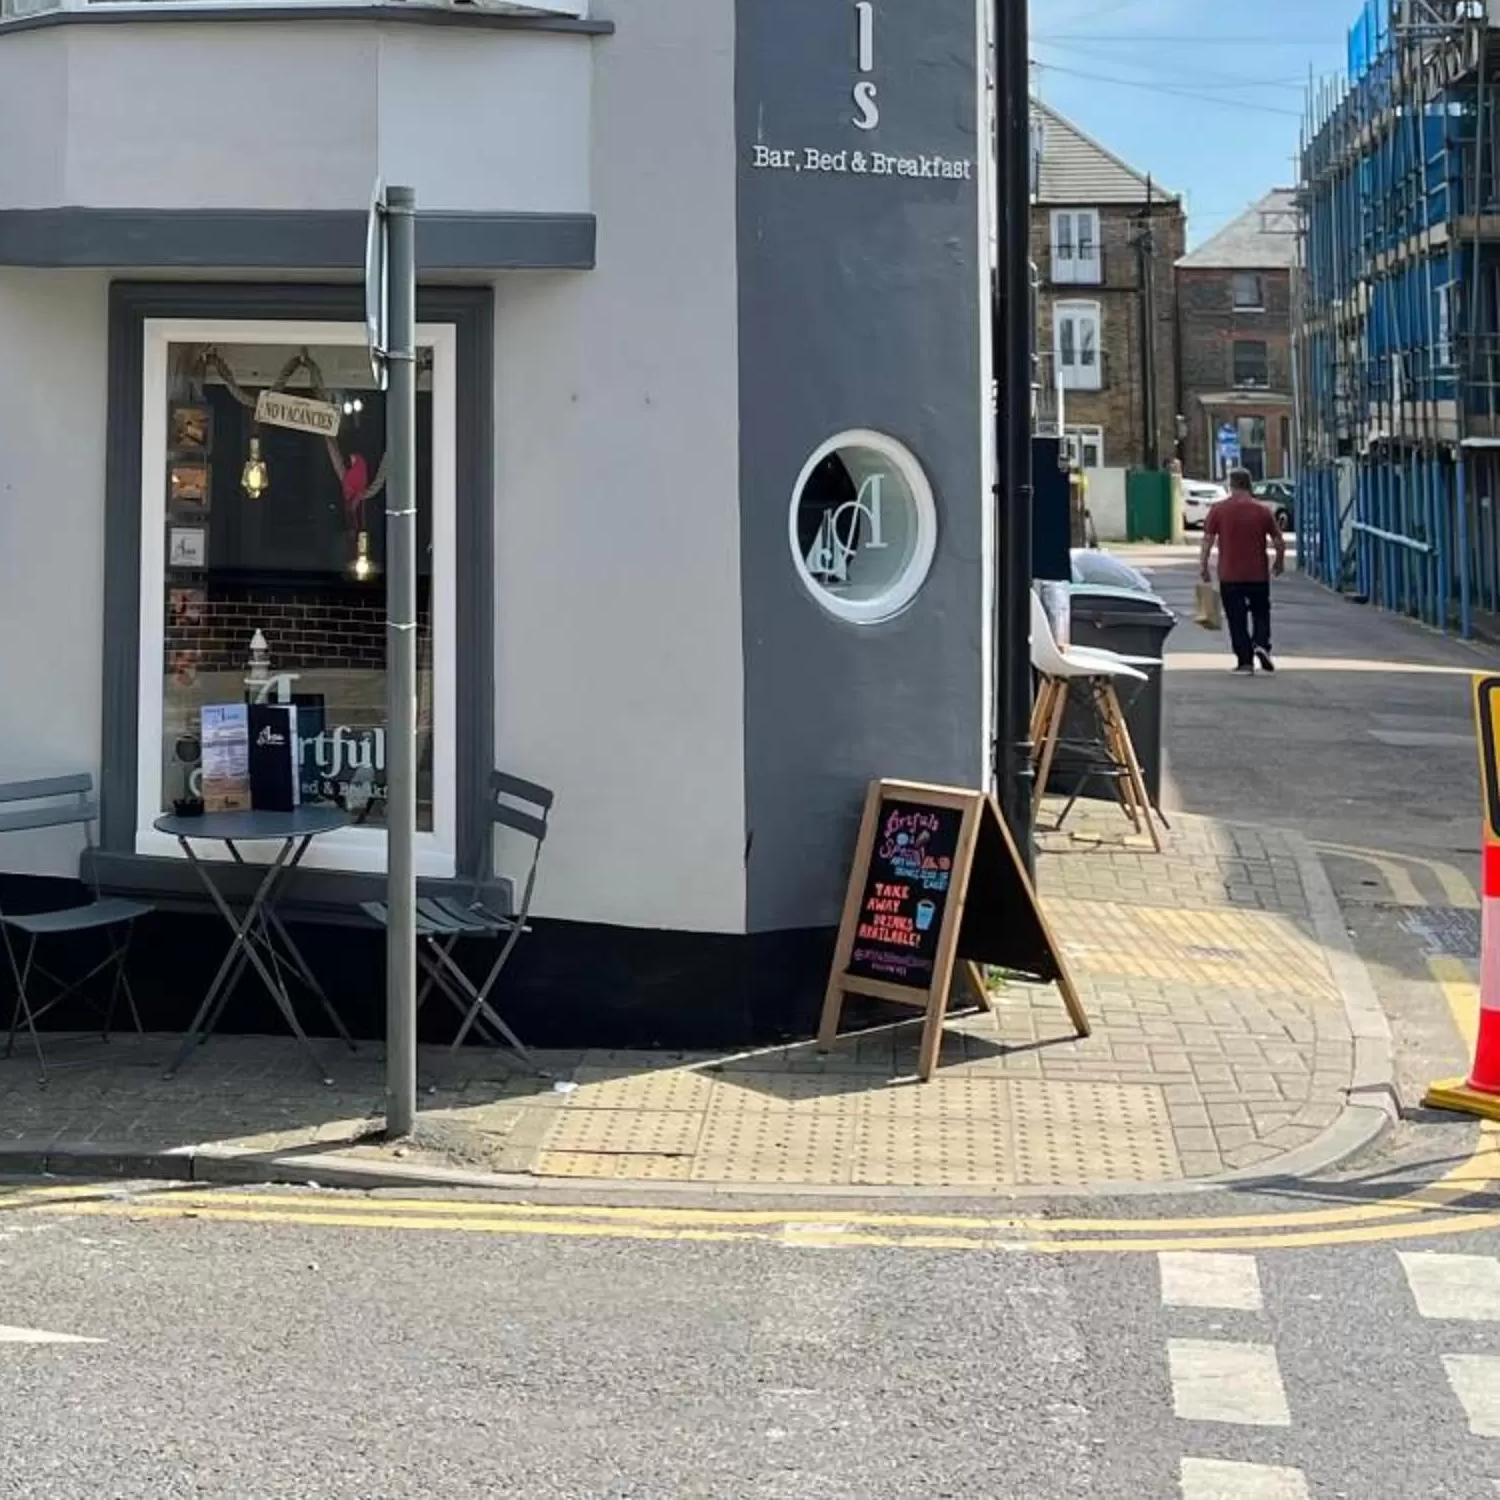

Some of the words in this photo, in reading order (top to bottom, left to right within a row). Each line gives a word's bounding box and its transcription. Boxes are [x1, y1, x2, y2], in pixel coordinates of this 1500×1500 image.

[753, 145, 800, 171] Bar,
[803, 147, 847, 171] Bed
[851, 151, 867, 173] &
[871, 152, 971, 179] Breakfast
[875, 883, 910, 899] TAKE
[866, 898, 901, 913] AWAY
